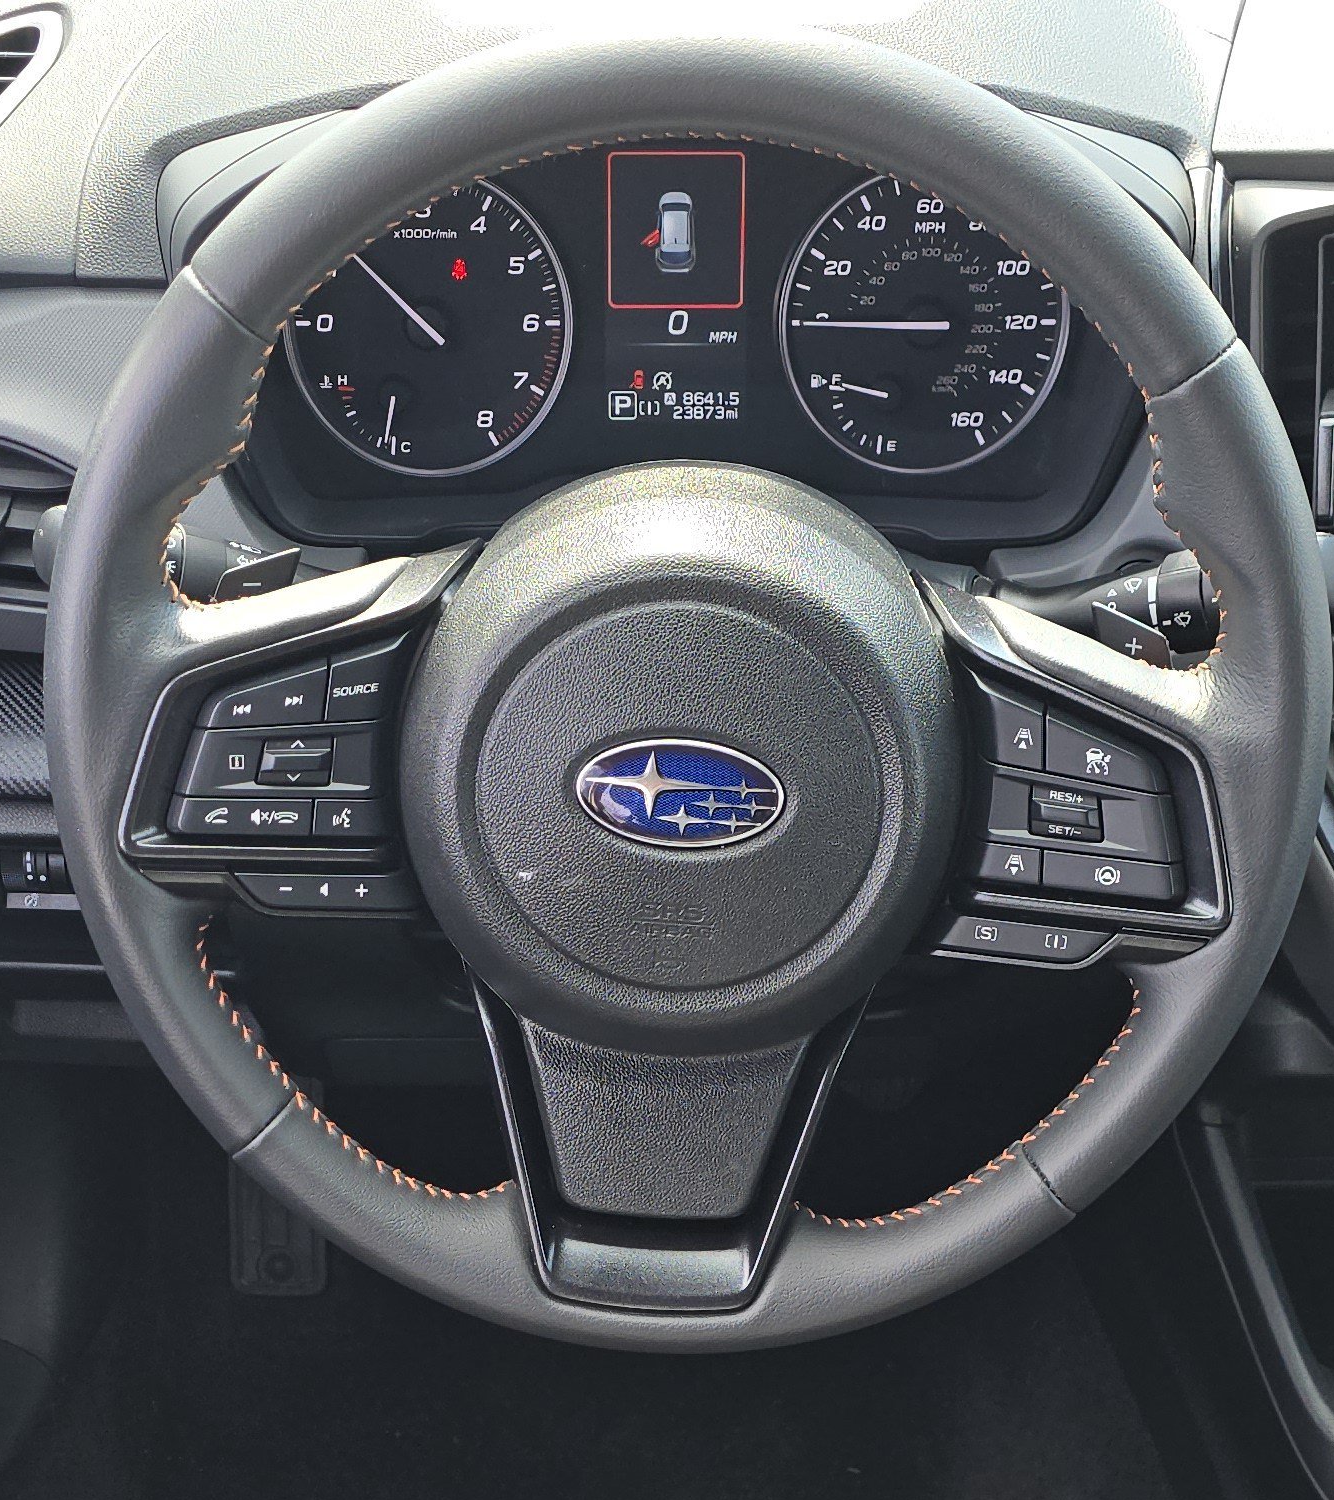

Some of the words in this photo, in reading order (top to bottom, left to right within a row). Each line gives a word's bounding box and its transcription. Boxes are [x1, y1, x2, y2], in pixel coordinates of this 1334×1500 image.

[917, 199, 945, 214] 60
[470, 216, 487, 234] 4
[857, 216, 886, 231] 40
[914, 222, 946, 234] MPH
[507, 256, 525, 275] 5
[823, 260, 852, 276] 20
[996, 260, 1030, 276] 100
[317, 314, 334, 332] 0
[522, 314, 540, 332] 6
[668, 310, 689, 336] 0
[1004, 315, 1038, 330] 120
[708, 331, 738, 344] MPH
[338, 375, 348, 386] H
[513, 371, 529, 390] 7
[831, 373, 843, 386] F
[988, 368, 1023, 385] 140
[614, 395, 632, 415] P
[682, 391, 740, 406] 8641.5
[476, 410, 493, 428] 8
[950, 411, 984, 427] 160
[400, 441, 411, 453] C
[886, 440, 897, 452] E
[332, 682, 380, 699] SOURCE
[1049, 788, 1084, 805] RES/+
